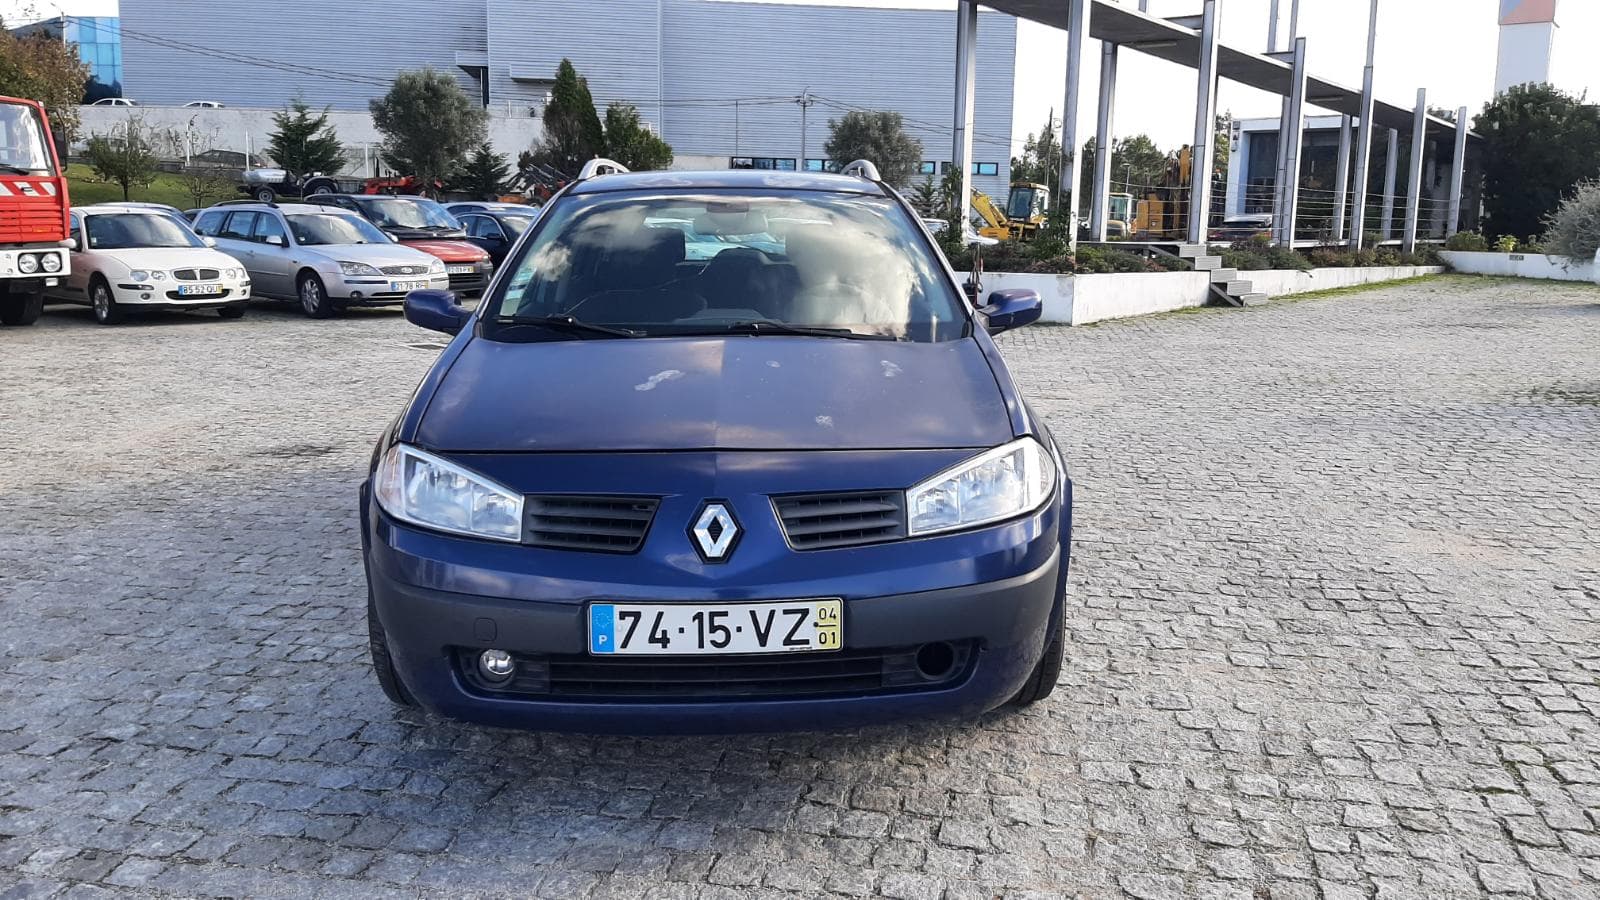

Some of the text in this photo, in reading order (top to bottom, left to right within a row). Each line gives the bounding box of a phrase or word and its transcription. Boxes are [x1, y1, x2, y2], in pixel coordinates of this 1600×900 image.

[818, 607, 837, 620] 04
[598, 634, 608, 645] P
[818, 631, 836, 645] 01
